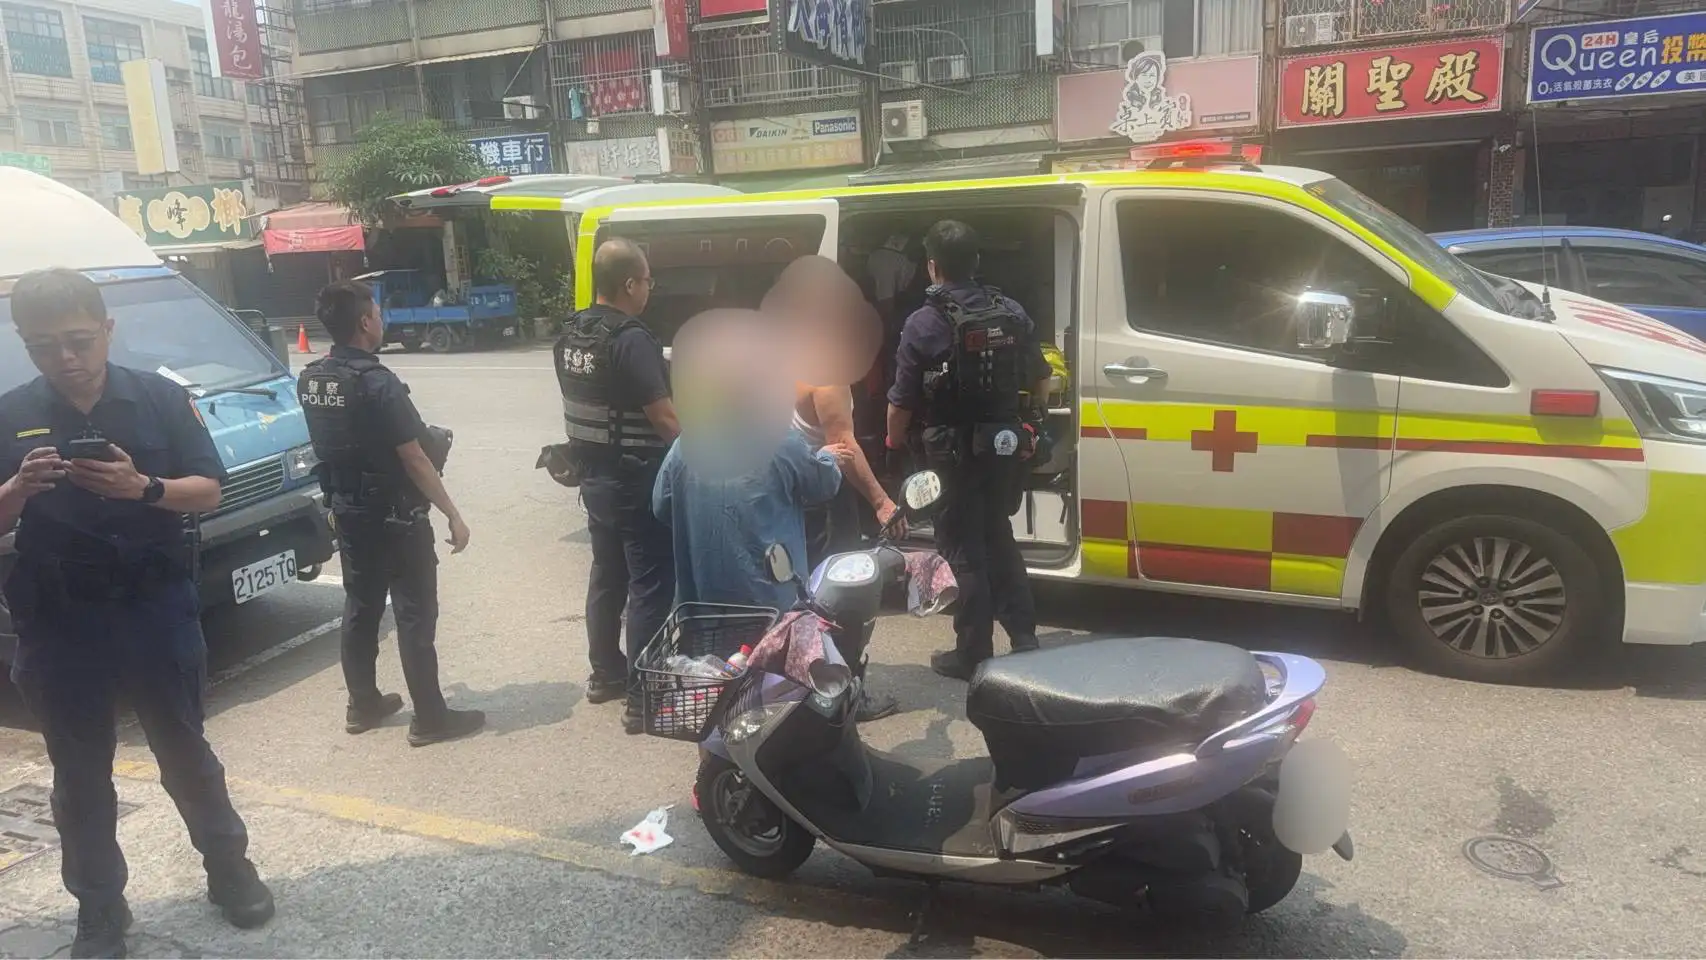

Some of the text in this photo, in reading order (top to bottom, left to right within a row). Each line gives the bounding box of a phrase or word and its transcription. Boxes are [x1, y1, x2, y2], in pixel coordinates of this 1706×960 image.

[1584, 30, 1659, 47] 24H 皇后
[1541, 34, 1656, 76] Queen
[1301, 51, 1485, 117] 關聖殿
[756, 128, 788, 138] DAIKIN
[815, 120, 856, 134] Panasonic
[468, 138, 545, 165] 機車行
[301, 394, 345, 407] POLICE
